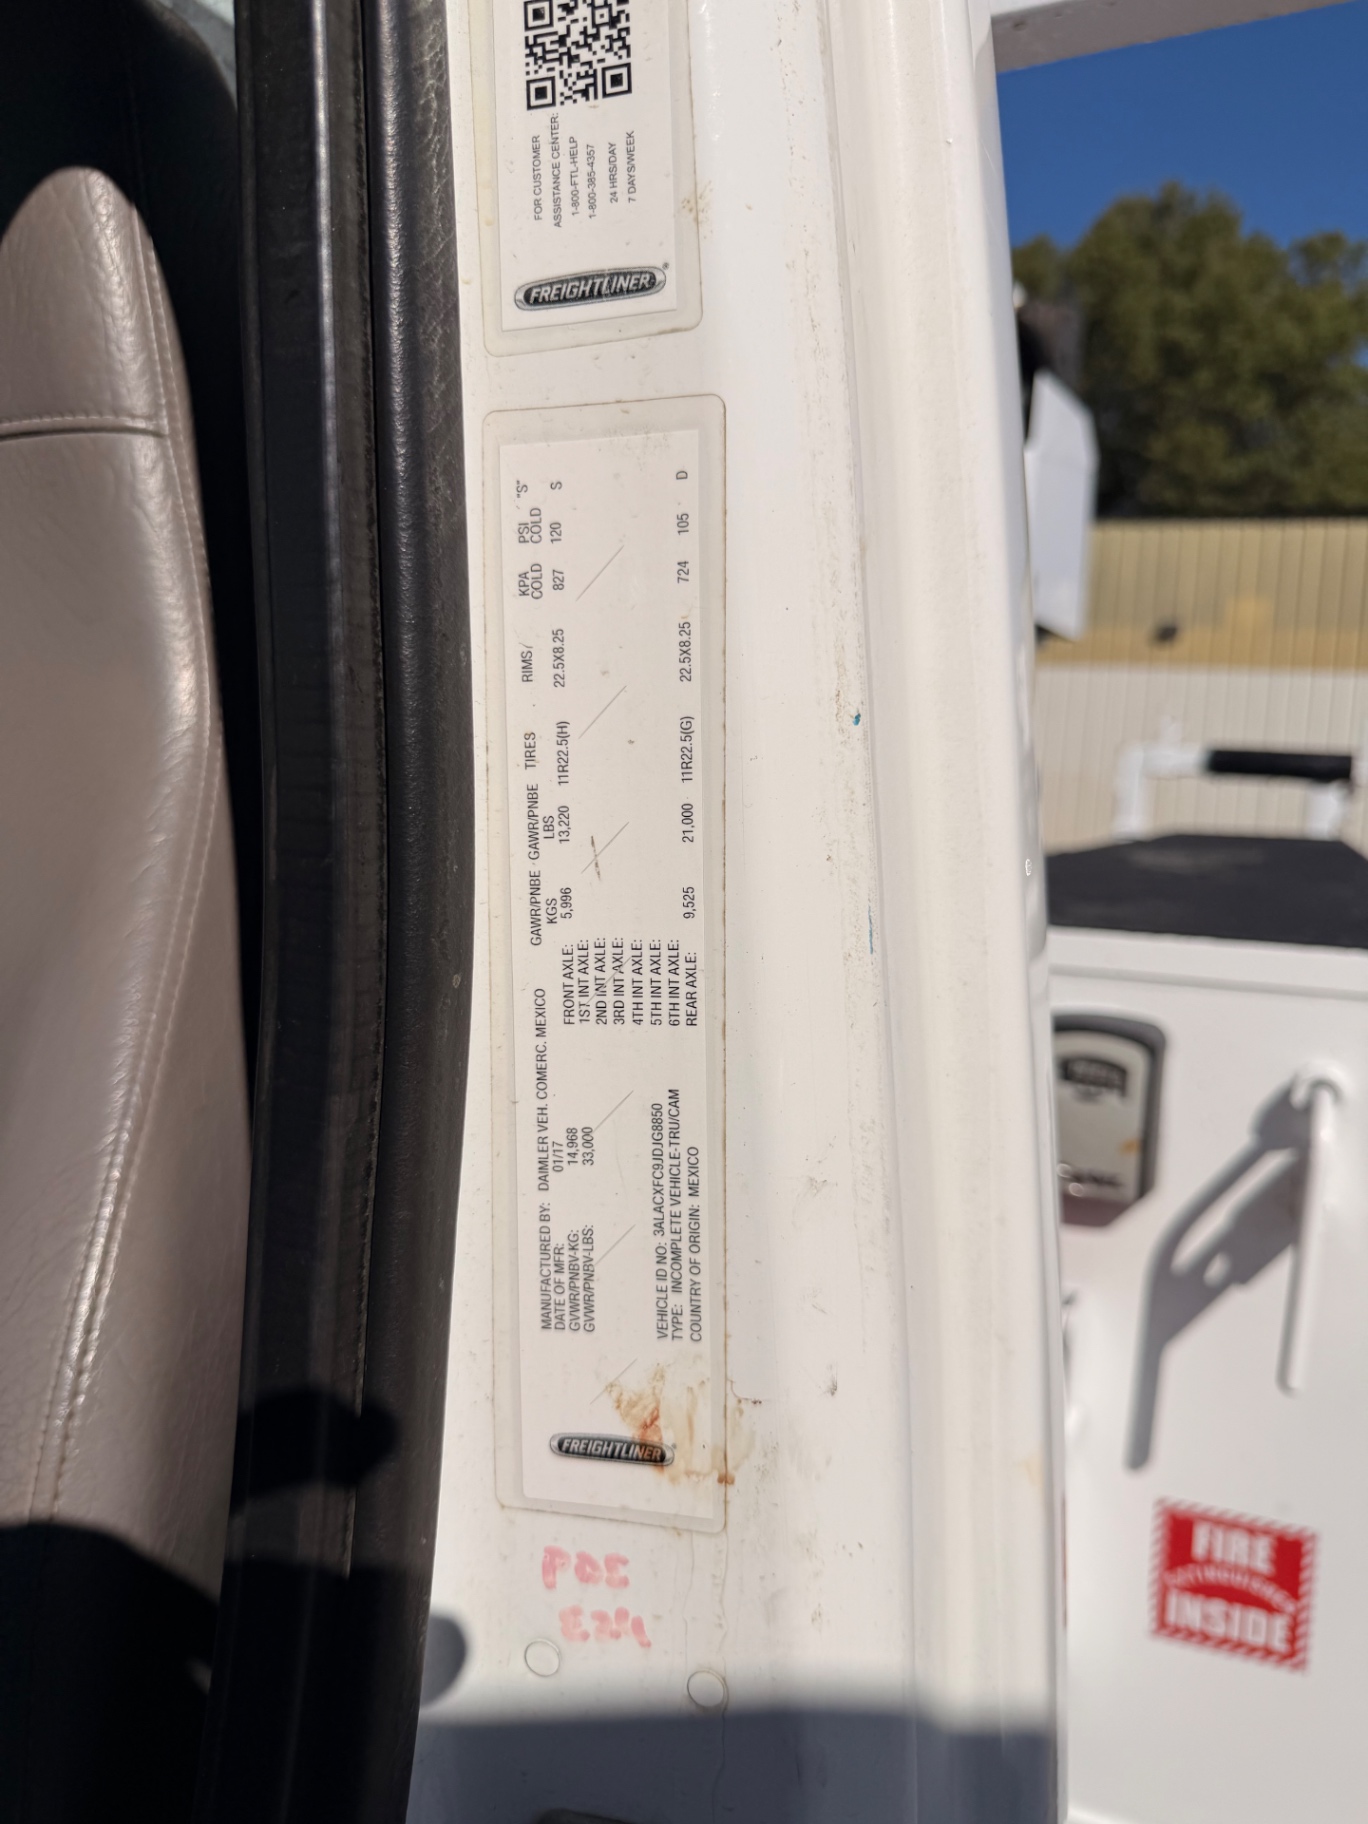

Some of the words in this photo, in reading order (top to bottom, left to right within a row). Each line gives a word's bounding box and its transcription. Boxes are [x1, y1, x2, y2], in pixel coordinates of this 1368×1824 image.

[551, 112, 560, 159] CENTER:
[531, 134, 542, 195] CUSTOMER
[569, 136, 579, 217] 1-800-FTL-HELP
[608, 142, 618, 188] HRS/DAY
[625, 130, 636, 195] DAYS/WEEK
[552, 161, 562, 228] ASSISTANCE
[586, 144, 597, 220] 1-800-385-4357
[610, 191, 619, 203] 24
[534, 198, 543, 221] FOR
[528, 272, 651, 304] FREIGHTLINER
[551, 480, 563, 490] S
[676, 470, 688, 480] D
[518, 522, 530, 544] PSI
[530, 507, 542, 544] COLD
[550, 522, 562, 544] 120
[677, 512, 689, 535] 105
[518, 571, 530, 597] KPA
[530, 563, 543, 600] COLD
[552, 569, 565, 591] 827
[677, 560, 690, 584] 724
[552, 628, 565, 688] 22.5X8.25
[679, 621, 692, 682] 22.5X8.25
[524, 731, 536, 770] TIRES
[556, 721, 570, 786] 11R22.5(H)
[680, 716, 694, 784] 11R22.5(G)
[527, 783, 540, 860] GAWR/PNBE
[543, 815, 555, 840] LBS
[558, 805, 571, 844] 13,220
[681, 803, 695, 843] 21,000
[529, 870, 542, 946] GAWR/PNBE
[546, 897, 558, 925] KGS
[560, 886, 573, 919] 5,996
[682, 886, 696, 919] 9,525
[562, 944, 574, 980] AXLE:
[577, 939, 589, 975] AXLE:
[594, 937, 606, 973] AXLE:
[612, 937, 624, 974] AXLE:
[631, 939, 643, 975] AXLE:
[650, 938, 661, 975] AXLE:
[668, 939, 679, 976] AXLE:
[685, 951, 697, 988] AXLE:
[563, 982, 575, 1025] FRONT
[578, 979, 590, 998] INT
[594, 976, 607, 997] INT
[613, 977, 625, 997] INT
[631, 978, 643, 999] INT
[650, 978, 662, 999] INT
[668, 978, 680, 999] INT
[534, 988, 547, 1037] MEXICO
[579, 1001, 590, 1024] 1ST
[595, 999, 607, 1025] 2ND
[613, 1000, 625, 1025] 3RD
[632, 1001, 644, 1025] 4TH
[651, 1001, 662, 1025] 5TH
[669, 1002, 680, 1026] 6TH
[686, 991, 698, 1026] REAR
[535, 1041, 548, 1100] COMERC.
[537, 1104, 548, 1134] VEH.
[537, 1135, 549, 1191] DAIMLER
[552, 1141, 564, 1173] 01/17
[566, 1127, 579, 1165] 14,968
[581, 1126, 595, 1166] 33,000
[668, 1088, 681, 1206] VEHICLE-TRU/CAM
[651, 1103, 665, 1237] 3ALACXFC9JDJG8850
[687, 1146, 700, 1197] MEXICO
[539, 1202, 551, 1223] BY:
[689, 1204, 701, 1254] ORIGIN:
[553, 1243, 565, 1275] MFR:
[655, 1242, 667, 1264] NO:
[670, 1209, 682, 1293] INCOMPLETE
[690, 1258, 701, 1275] OF
[540, 1225, 552, 1330] MANUFACTURED
[553, 1278, 565, 1296] OF
[567, 1229, 580, 1332] GVWR/PNBV-KG:
[582, 1224, 595, 1333] GVWR/PNBV-LBS:
[656, 1267, 668, 1283] ID
[553, 1299, 566, 1331] DATE
[656, 1285, 669, 1340] VEHICLE
[672, 1304, 683, 1341] TYPE:
[690, 1279, 702, 1342] COUNTRY
[561, 1438, 662, 1461] FREIGHTLINER
[1190, 1521, 1276, 1577] FIRE
[1165, 1588, 1291, 1656] INSIDE
